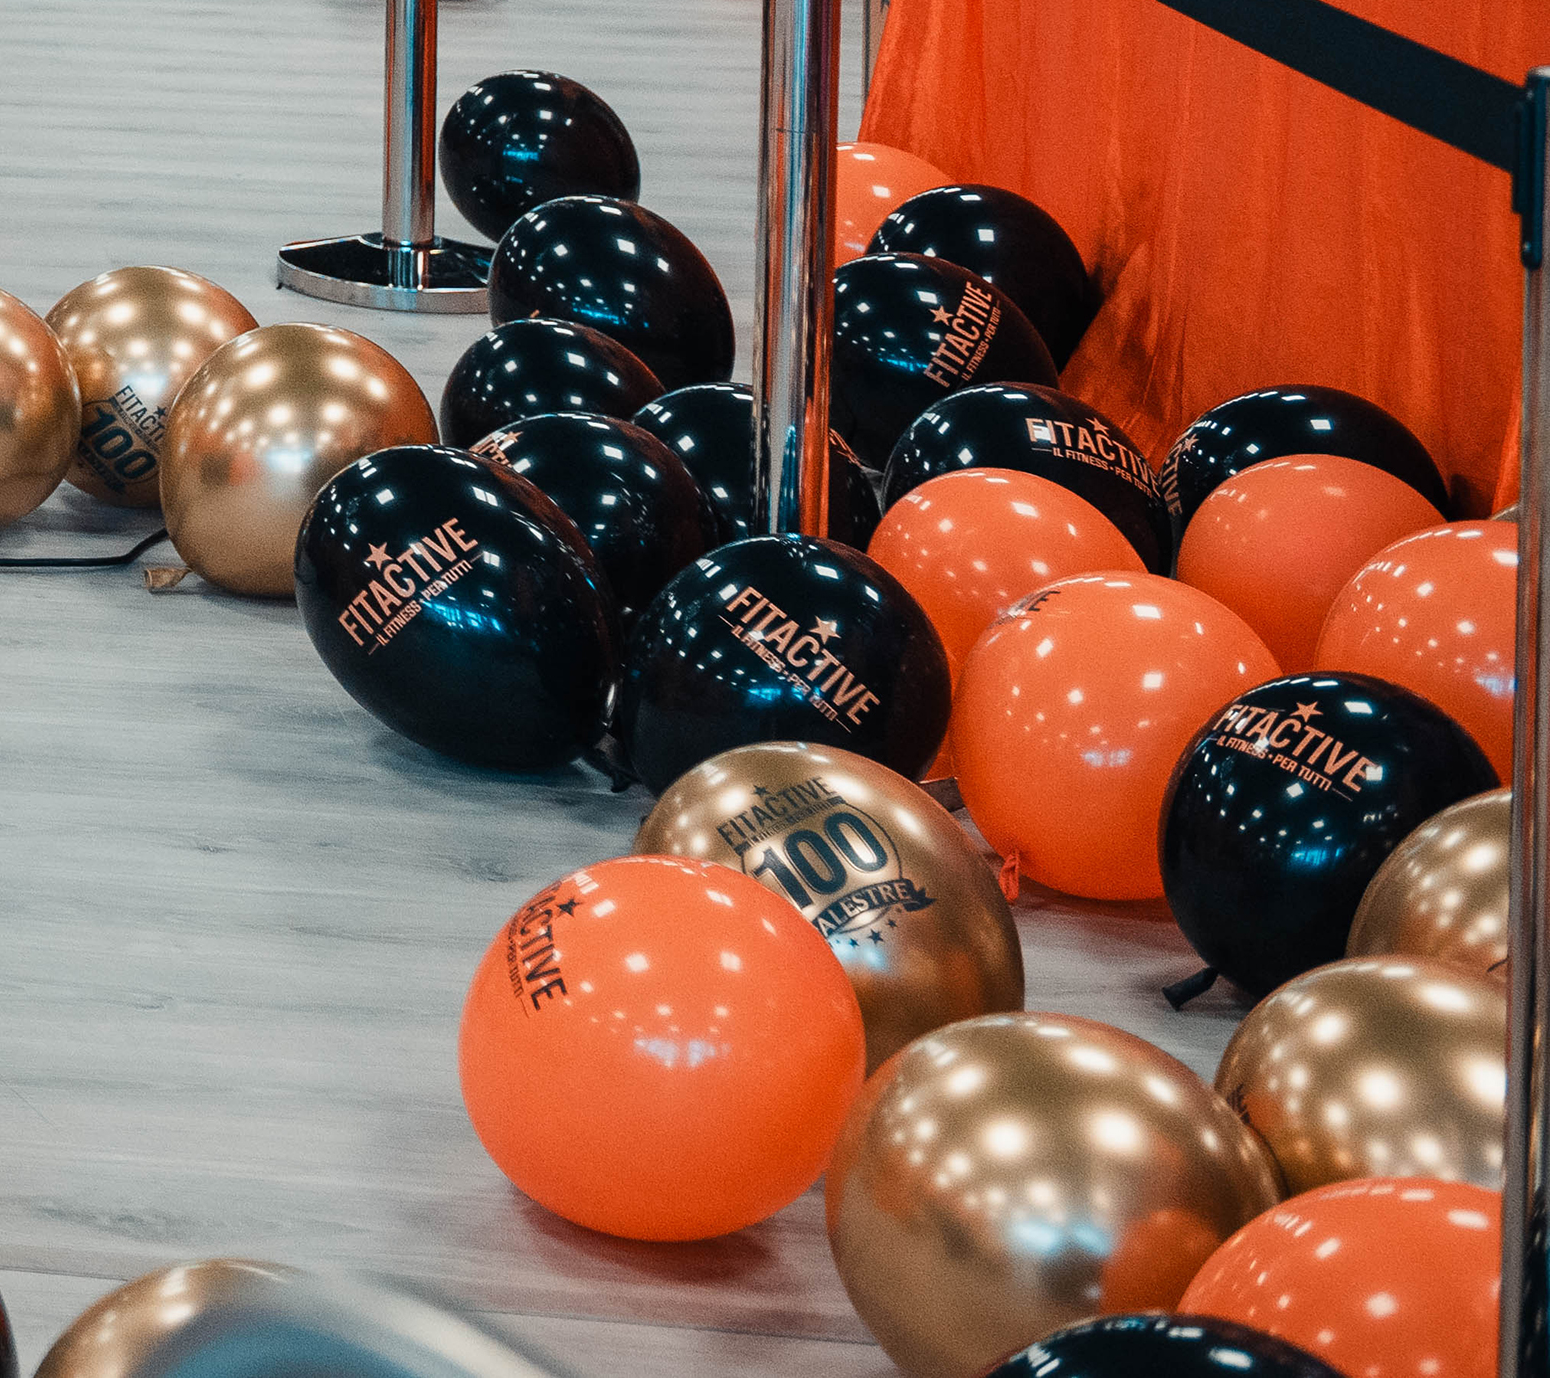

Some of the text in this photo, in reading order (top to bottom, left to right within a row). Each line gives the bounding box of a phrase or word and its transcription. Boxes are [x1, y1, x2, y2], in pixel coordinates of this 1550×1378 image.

[925, 281, 993, 388] FITACTIVE
[967, 341, 988, 375] FITNESS
[986, 325, 996, 340] PER
[1053, 447, 1063, 456] IL
[1066, 450, 1109, 470] FITNESS
[1115, 466, 1129, 479] PER
[339, 518, 478, 648] FITACTIVE
[377, 559, 473, 647] IL FITNESS PER TUTTI
[726, 586, 880, 725] FITACTIVE
[731, 626, 743, 637] IL
[742, 635, 785, 674] FITNESS
[787, 672, 811, 694] PER
[1212, 704, 1377, 792] FITACTIVE
[1217, 735, 1332, 792] IL FITNESS PER TUTTI
[717, 776, 833, 852] FITACTIVE
[757, 811, 889, 909] 100
[817, 880, 911, 937] ALESTRE
